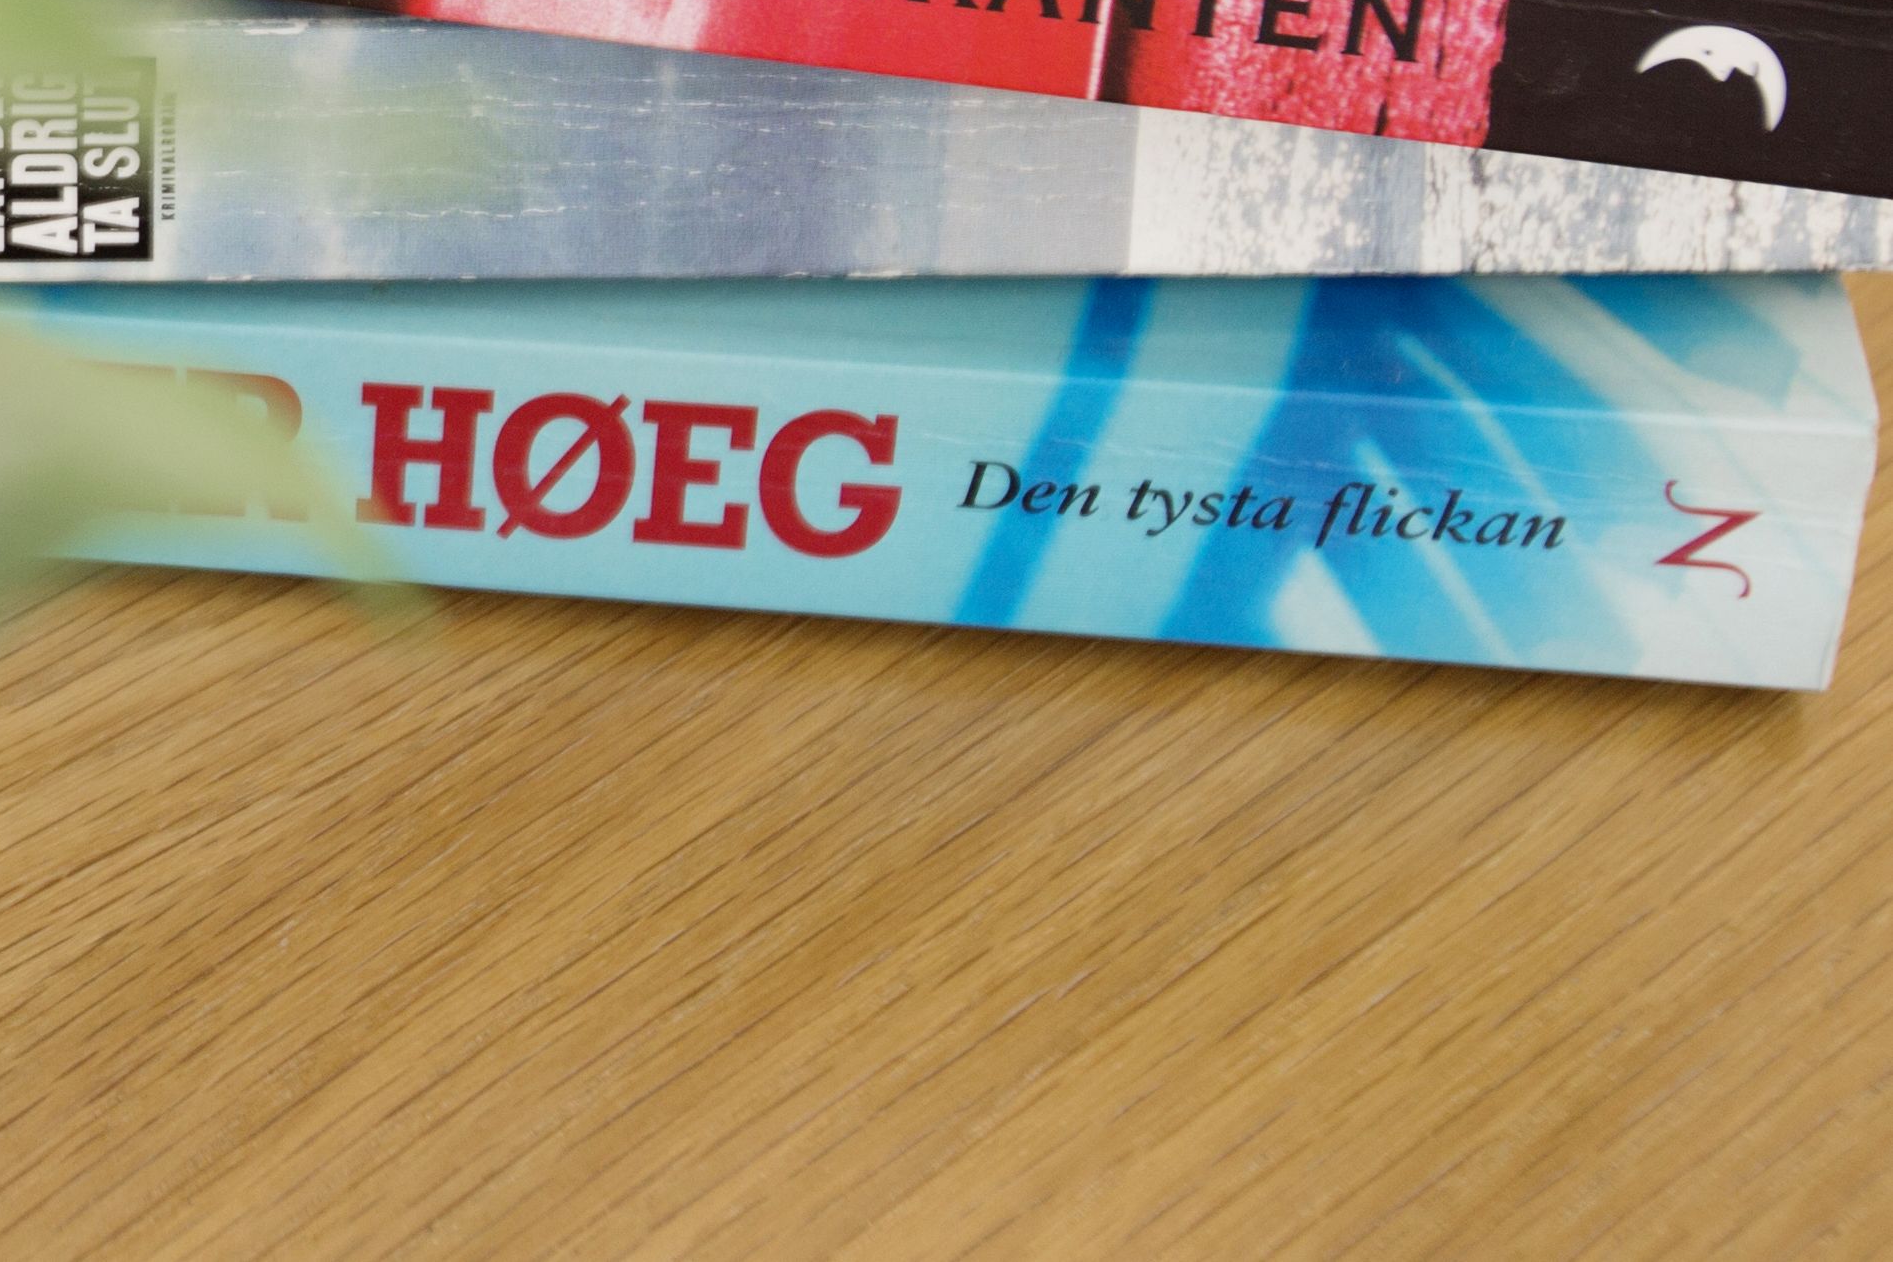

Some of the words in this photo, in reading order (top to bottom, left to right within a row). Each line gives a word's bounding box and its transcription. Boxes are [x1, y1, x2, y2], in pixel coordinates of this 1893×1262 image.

[11, 73, 79, 255] ALDRIG
[82, 196, 140, 254] TA
[355, 381, 902, 559] HØEG
[956, 460, 1101, 517] Den
[1126, 476, 1295, 539] tysta
[1314, 481, 1569, 552] flickan
